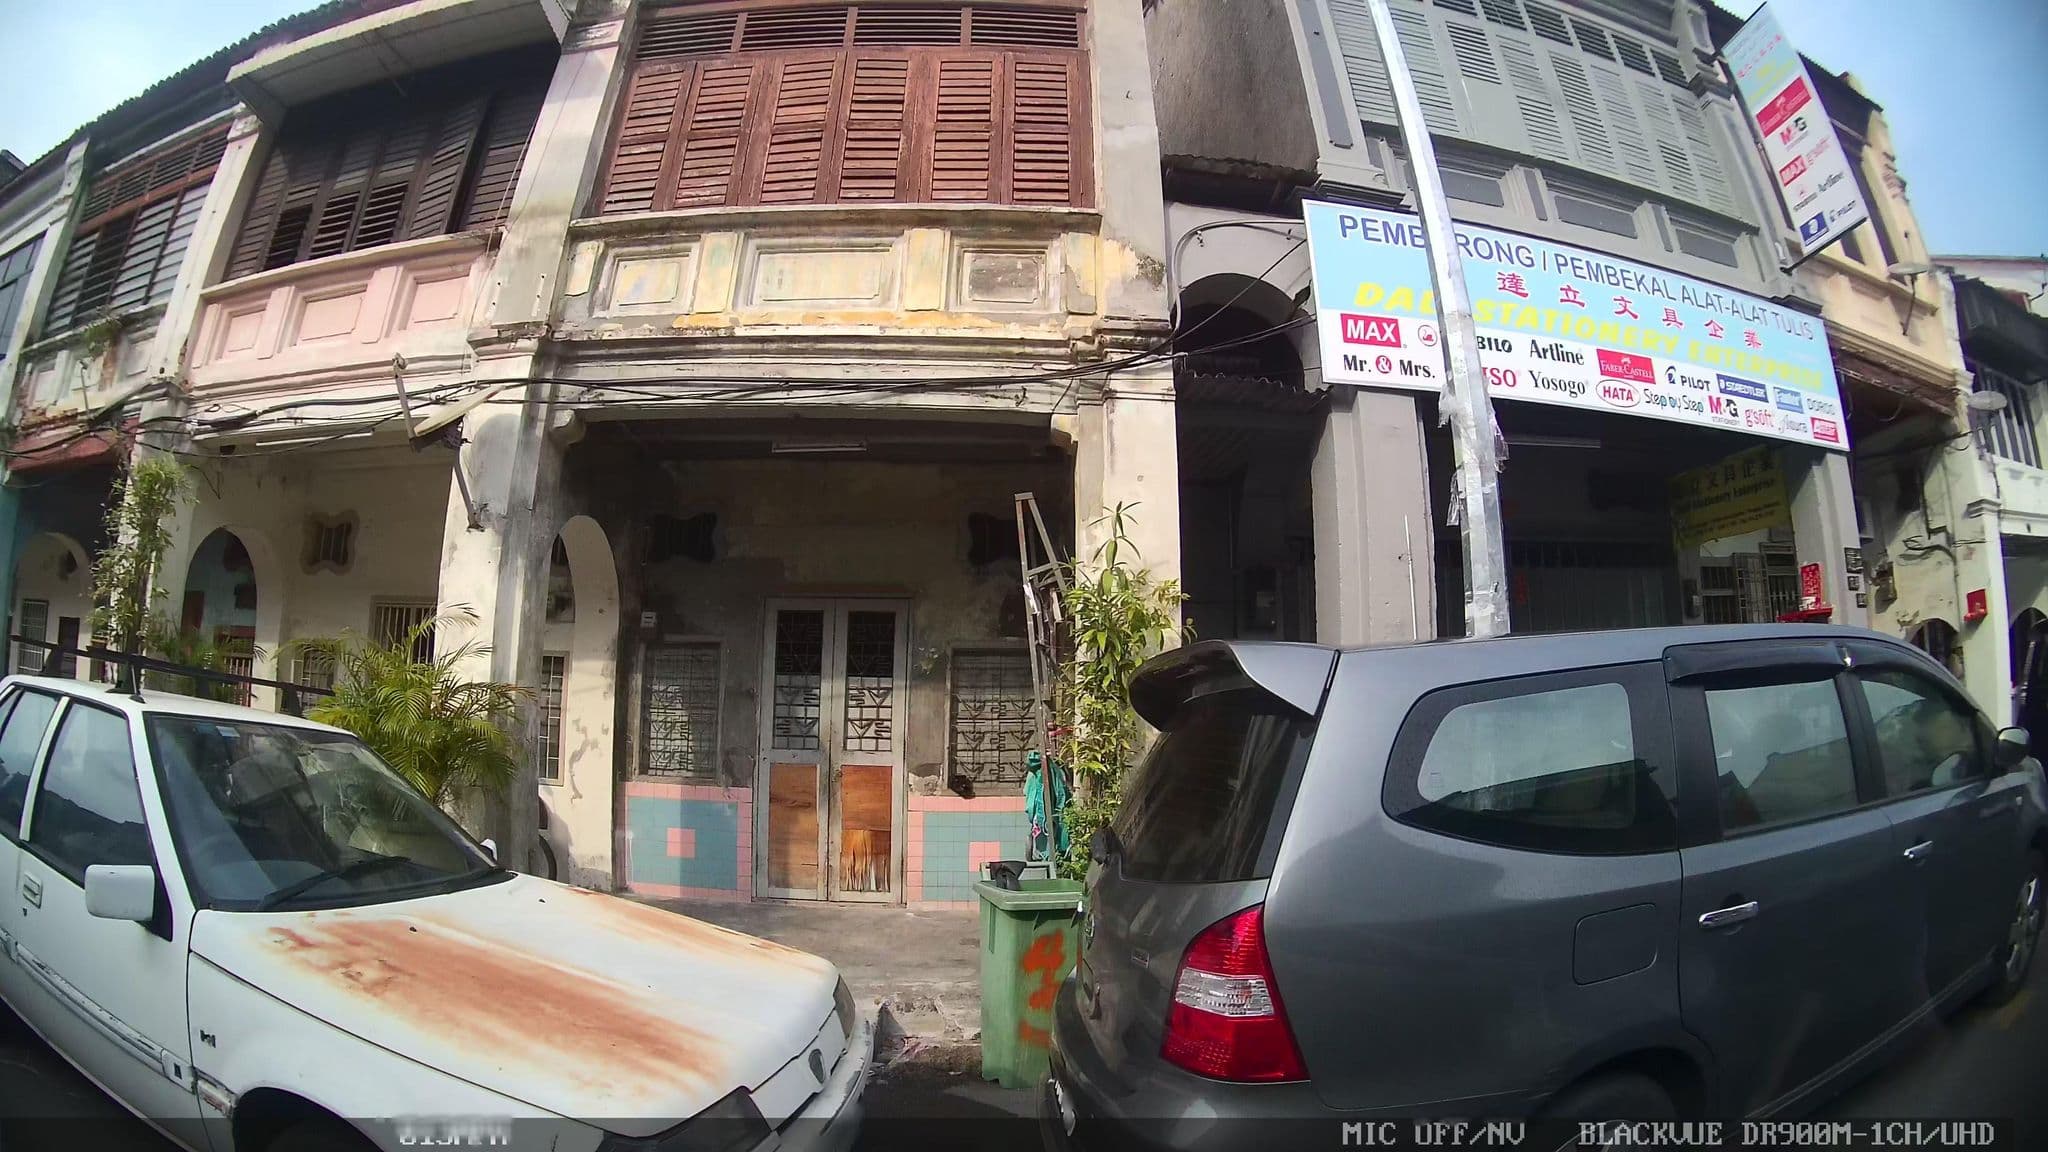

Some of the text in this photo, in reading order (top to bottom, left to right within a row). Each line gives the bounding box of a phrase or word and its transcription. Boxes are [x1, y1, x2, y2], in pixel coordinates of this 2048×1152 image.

[1780, 156, 1807, 185] MAX
[1339, 214, 1535, 267] PEMBRONG
[1554, 253, 1677, 301] PEMBEKAL
[1682, 285, 1768, 326] ALAT-ALAT
[1771, 311, 1814, 341] TULIS
[1347, 319, 1397, 342] MAX
[1474, 298, 1680, 353] STATIONERY
[1688, 340, 1824, 391] ENTERPRISE
[1529, 338, 1585, 365] Artline
[1343, 354, 1372, 373] Mr.
[1399, 359, 1436, 379] Mrs.
[1528, 369, 1586, 398] Yosogo
[1602, 385, 1634, 402] HATA
[1680, 375, 1711, 392] PILOT
[1643, 389, 1667, 409] Step
[1682, 395, 1704, 415] Step
